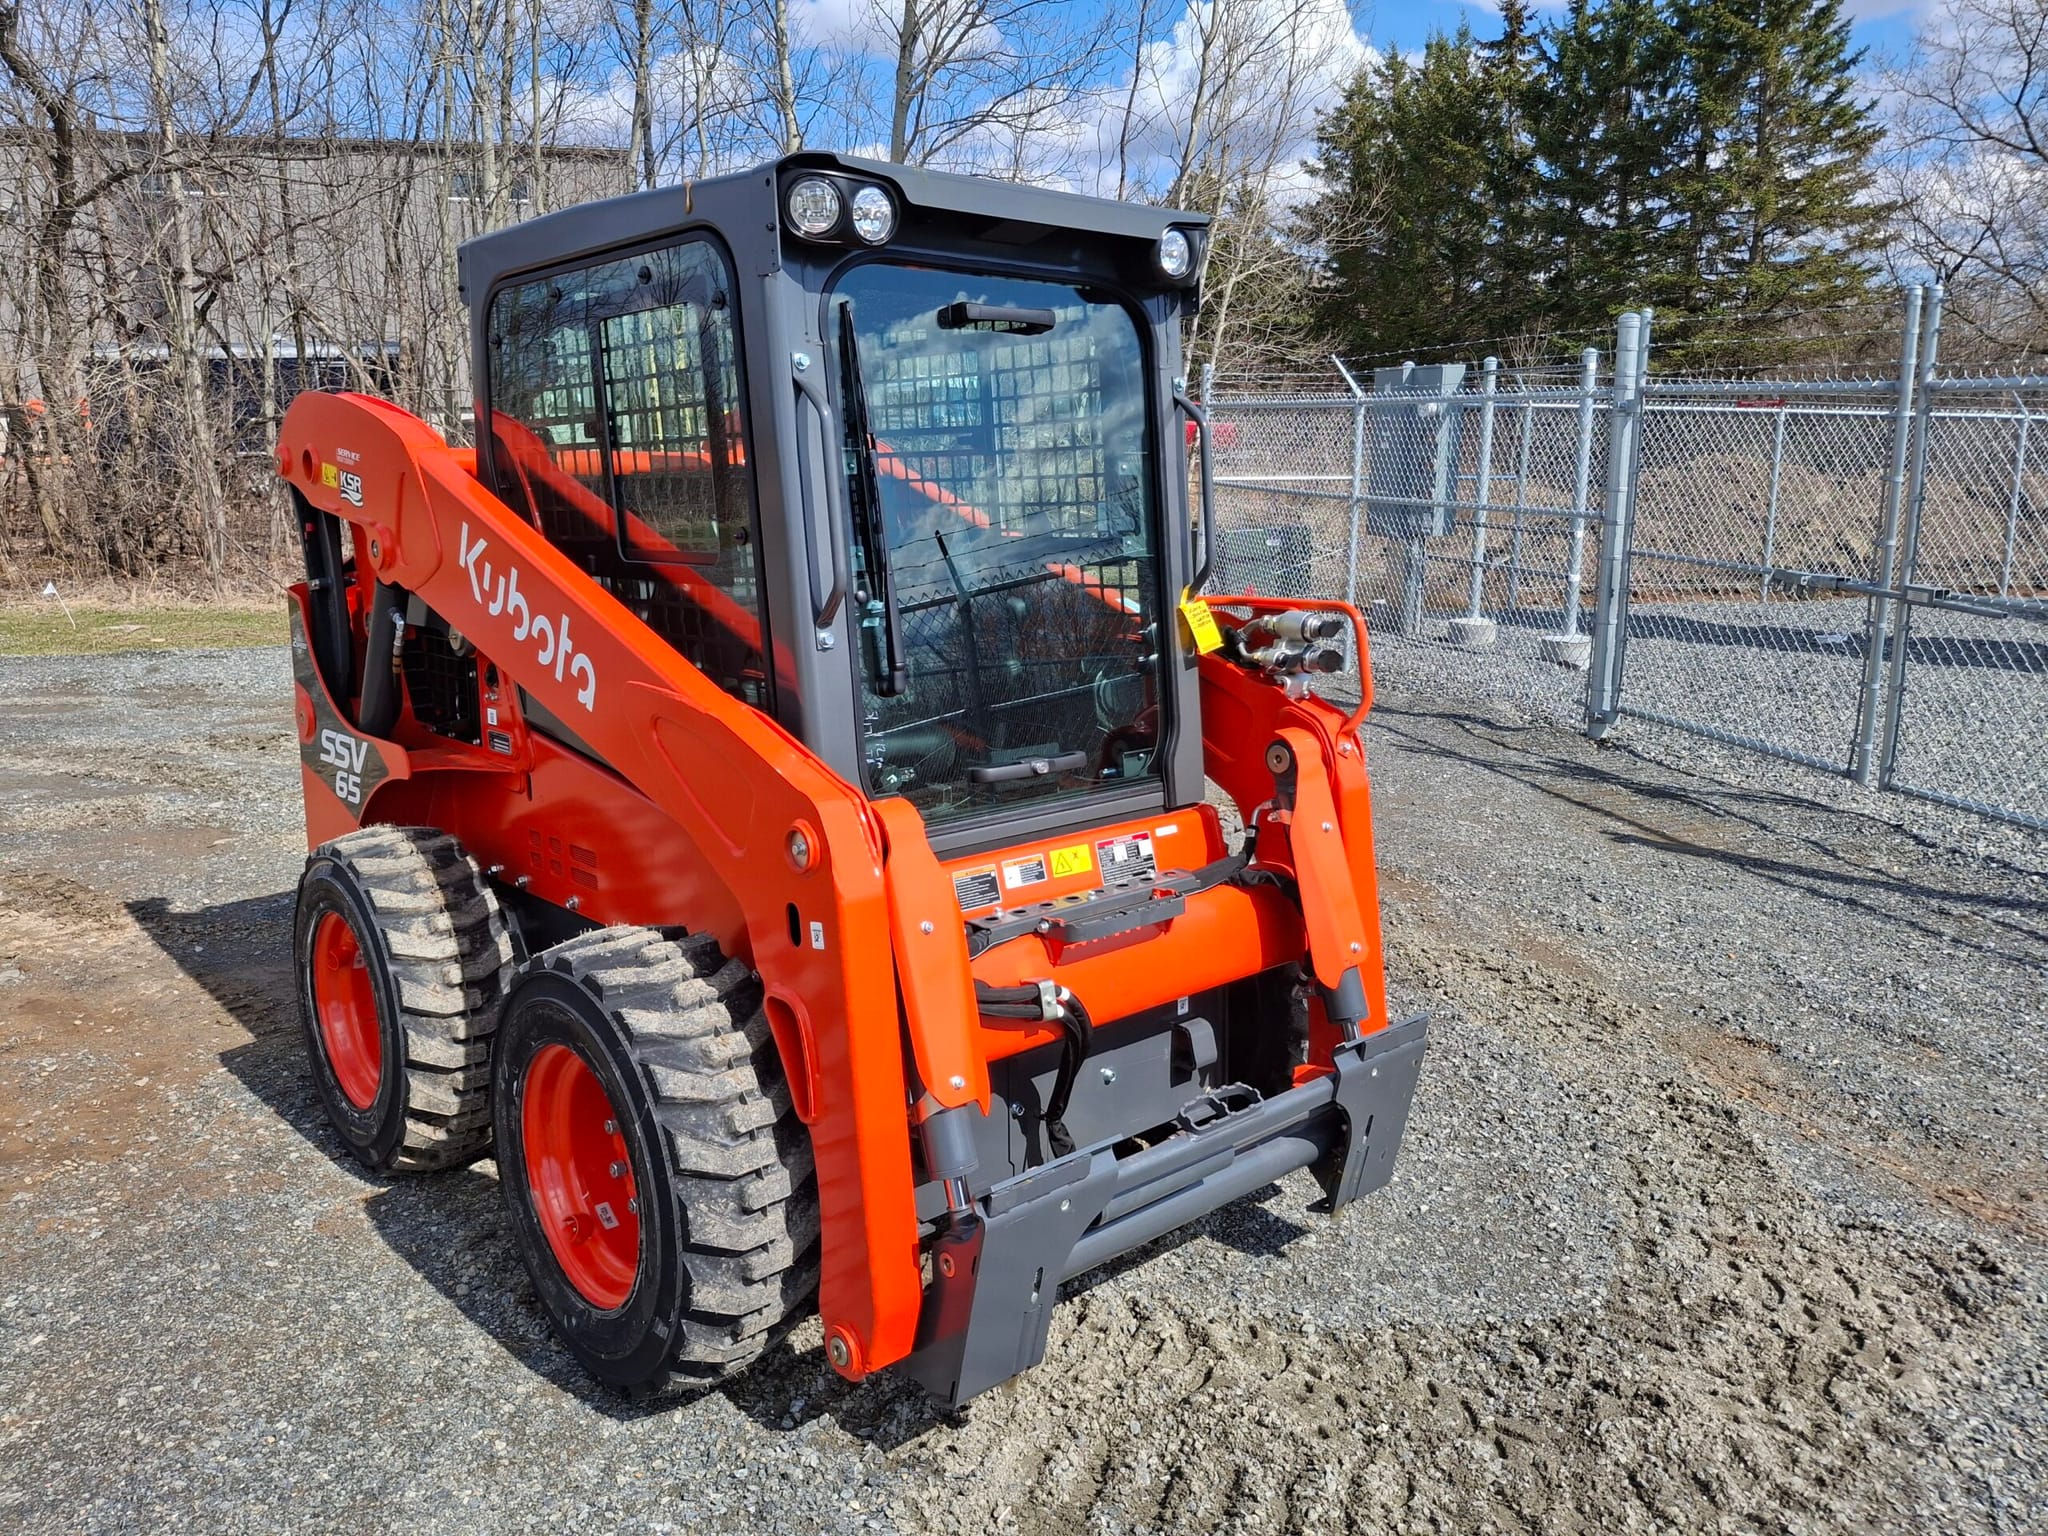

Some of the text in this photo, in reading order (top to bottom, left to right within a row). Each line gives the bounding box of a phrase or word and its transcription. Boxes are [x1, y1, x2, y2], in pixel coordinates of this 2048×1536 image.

[336, 447, 361, 462] SERVICE
[340, 471, 362, 493] KSR
[459, 521, 596, 712] Kubota
[320, 728, 369, 774] SSV
[335, 770, 361, 804] 65
